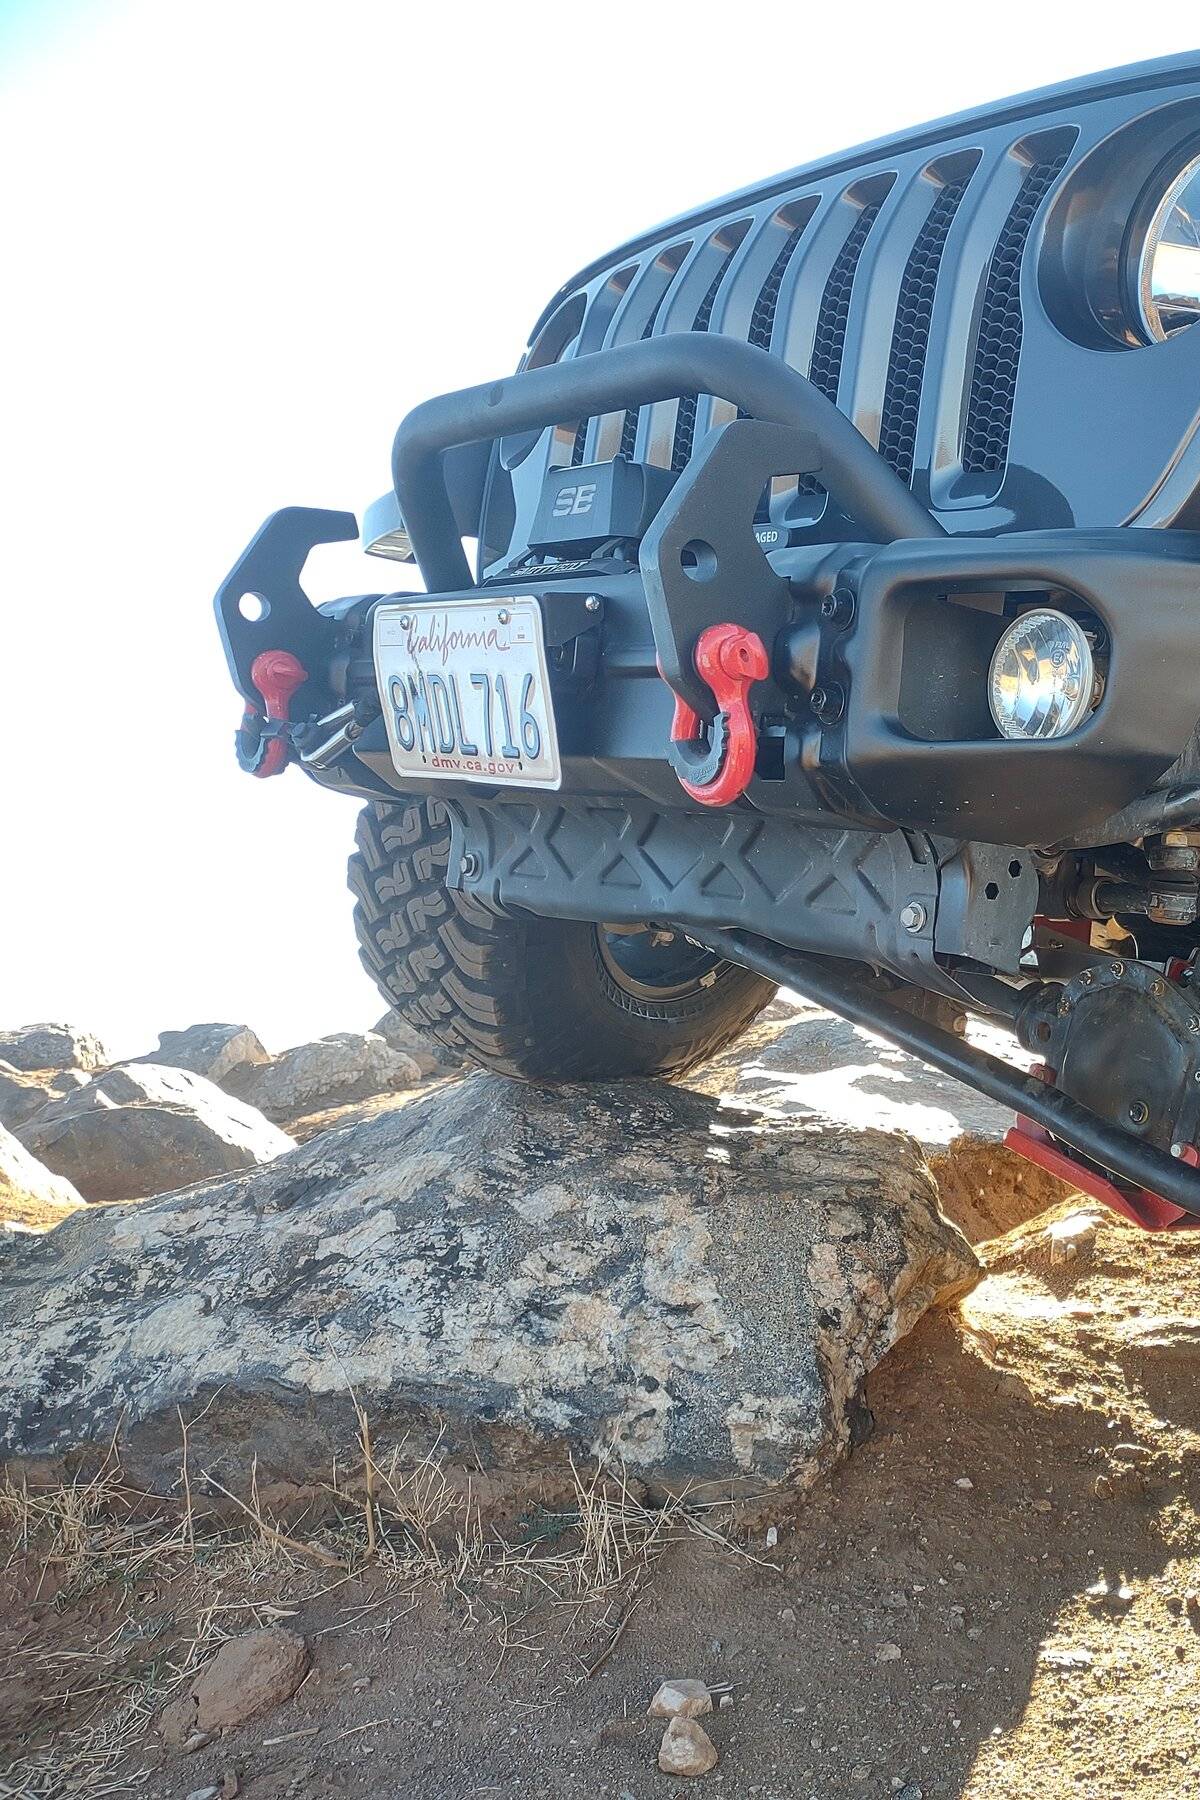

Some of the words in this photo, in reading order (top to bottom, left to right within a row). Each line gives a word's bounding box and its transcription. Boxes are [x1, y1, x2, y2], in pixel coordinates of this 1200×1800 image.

[552, 484, 597, 517] SE
[406, 613, 510, 667] California
[431, 755, 515, 775] dmv.ca.gov
